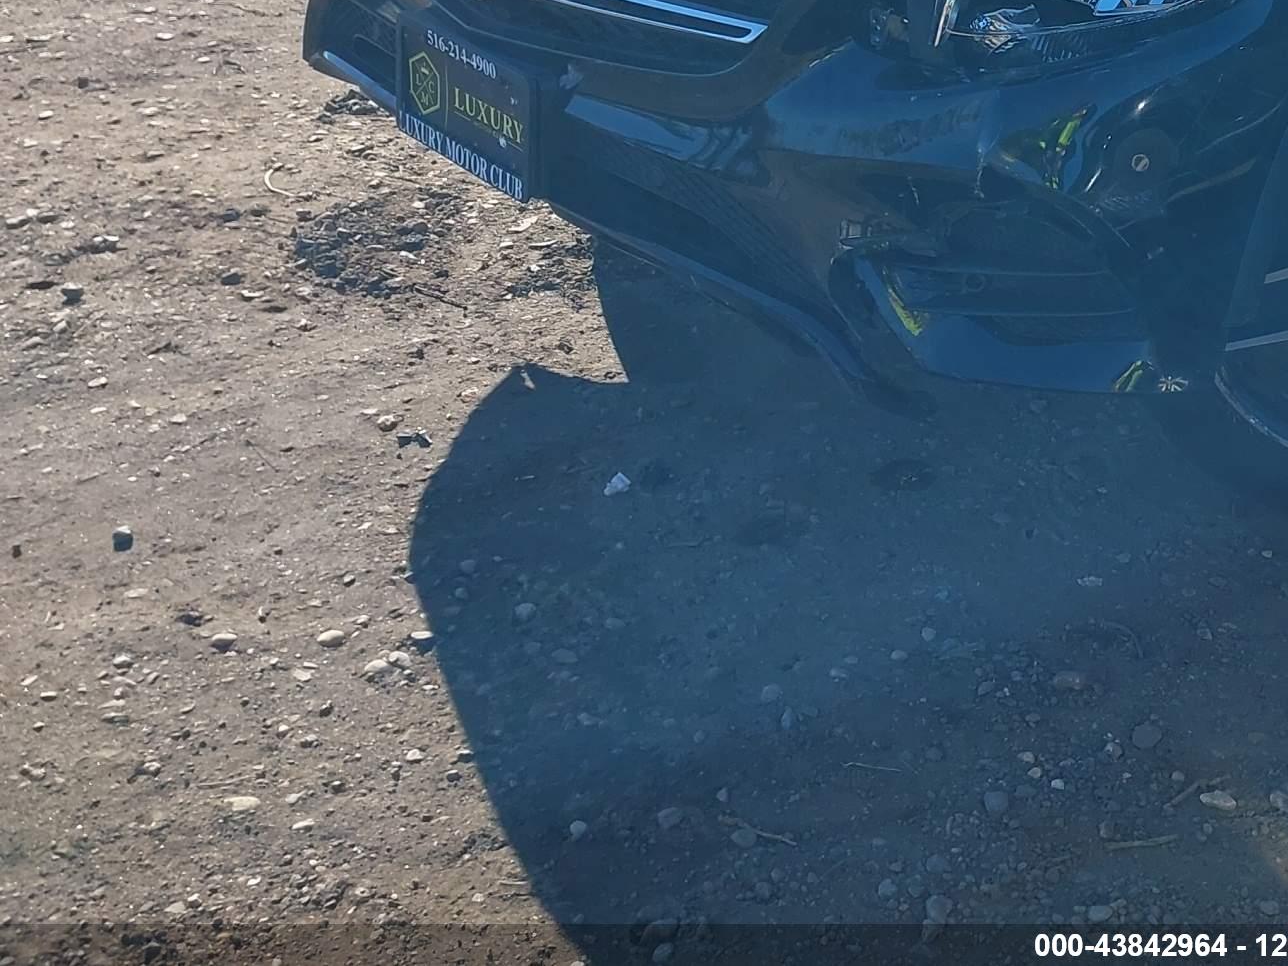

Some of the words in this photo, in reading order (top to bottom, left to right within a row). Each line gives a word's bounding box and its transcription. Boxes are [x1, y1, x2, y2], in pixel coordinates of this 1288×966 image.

[427, 30, 496, 79] 516-214-4900
[454, 87, 524, 144] LUXURY
[400, 111, 444, 153] LUXURY
[446, 141, 488, 184] MOTOR
[490, 164, 524, 200] CLUB
